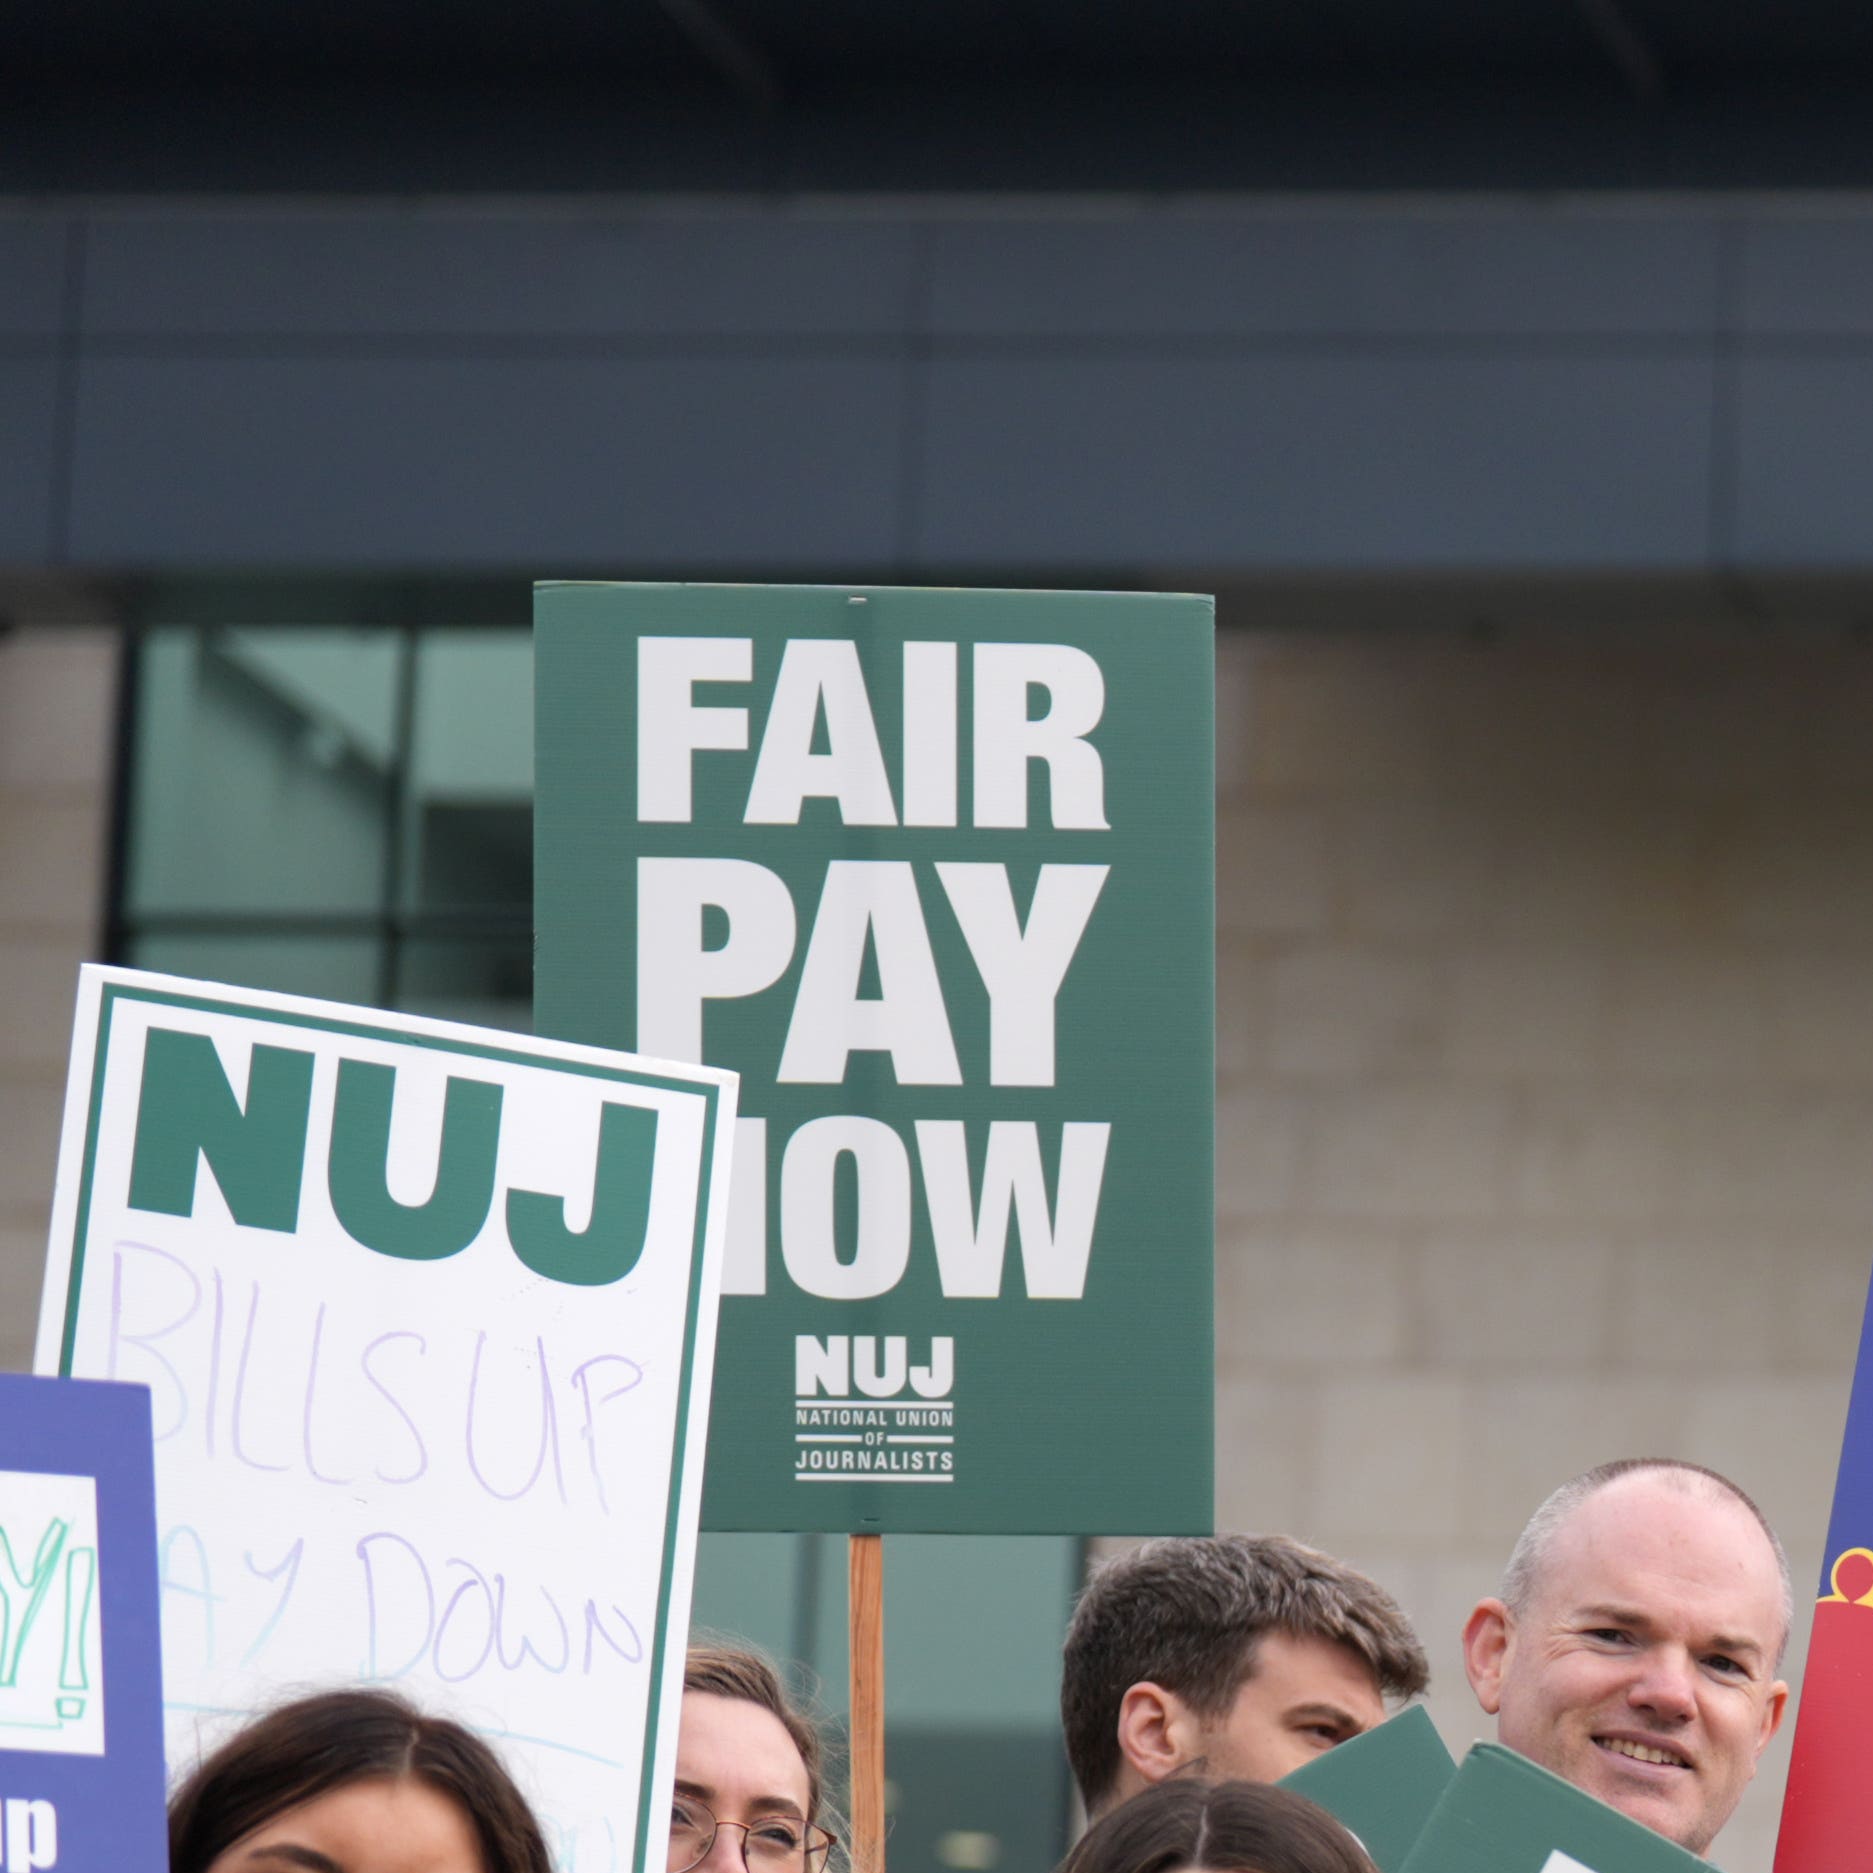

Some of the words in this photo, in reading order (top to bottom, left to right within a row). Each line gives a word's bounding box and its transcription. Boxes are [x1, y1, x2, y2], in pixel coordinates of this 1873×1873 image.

[636, 635, 1112, 831] FAIR
[636, 856, 1112, 1087] PAY
[126, 1025, 660, 1287] NUJ
[795, 1334, 955, 1399] NUJ
[795, 1409, 888, 1426] NATIONAL
[896, 1410, 954, 1427] UNION
[795, 1450, 954, 1471] JOURNALISTS
[865, 1431, 885, 1447] OF
[159, 1525, 304, 1670] AY
